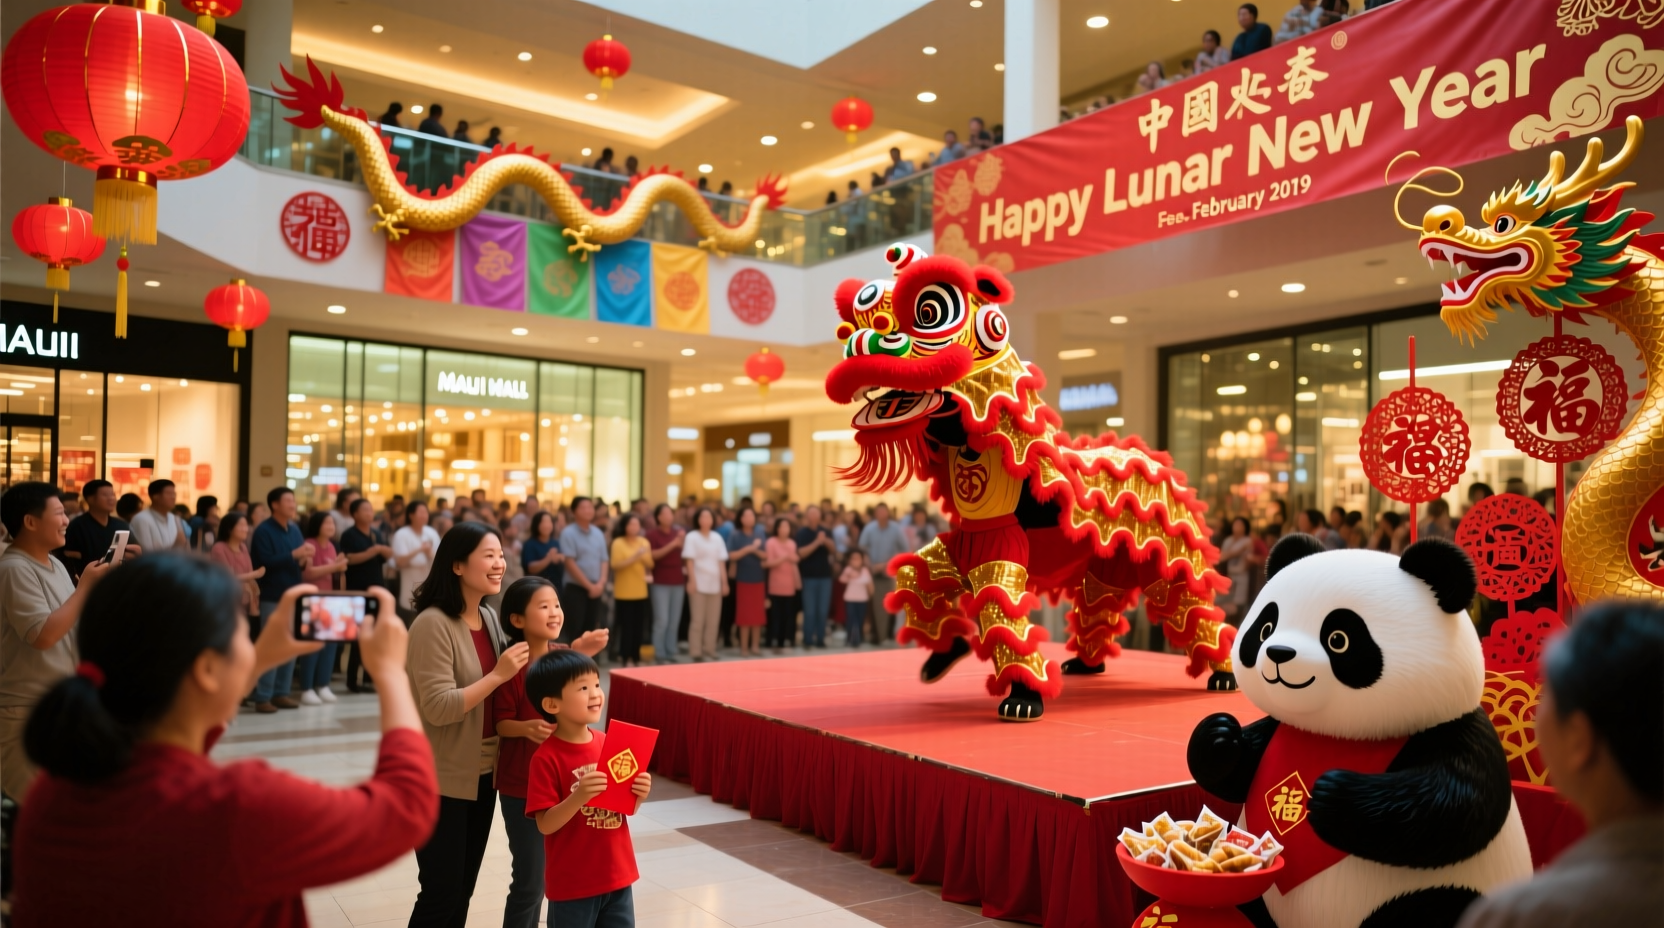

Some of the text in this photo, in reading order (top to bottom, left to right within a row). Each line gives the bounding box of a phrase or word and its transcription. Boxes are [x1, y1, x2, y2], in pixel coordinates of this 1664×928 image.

[978, 43, 1547, 247] Happy Lunar New Year
[1192, 189, 1265, 220] February
[1269, 174, 1312, 202] 2019
[0, 323, 79, 359] AUII
[1523, 358, 1601, 435] 福
[1382, 415, 1442, 475] 福
[1271, 786, 1304, 823] 福
